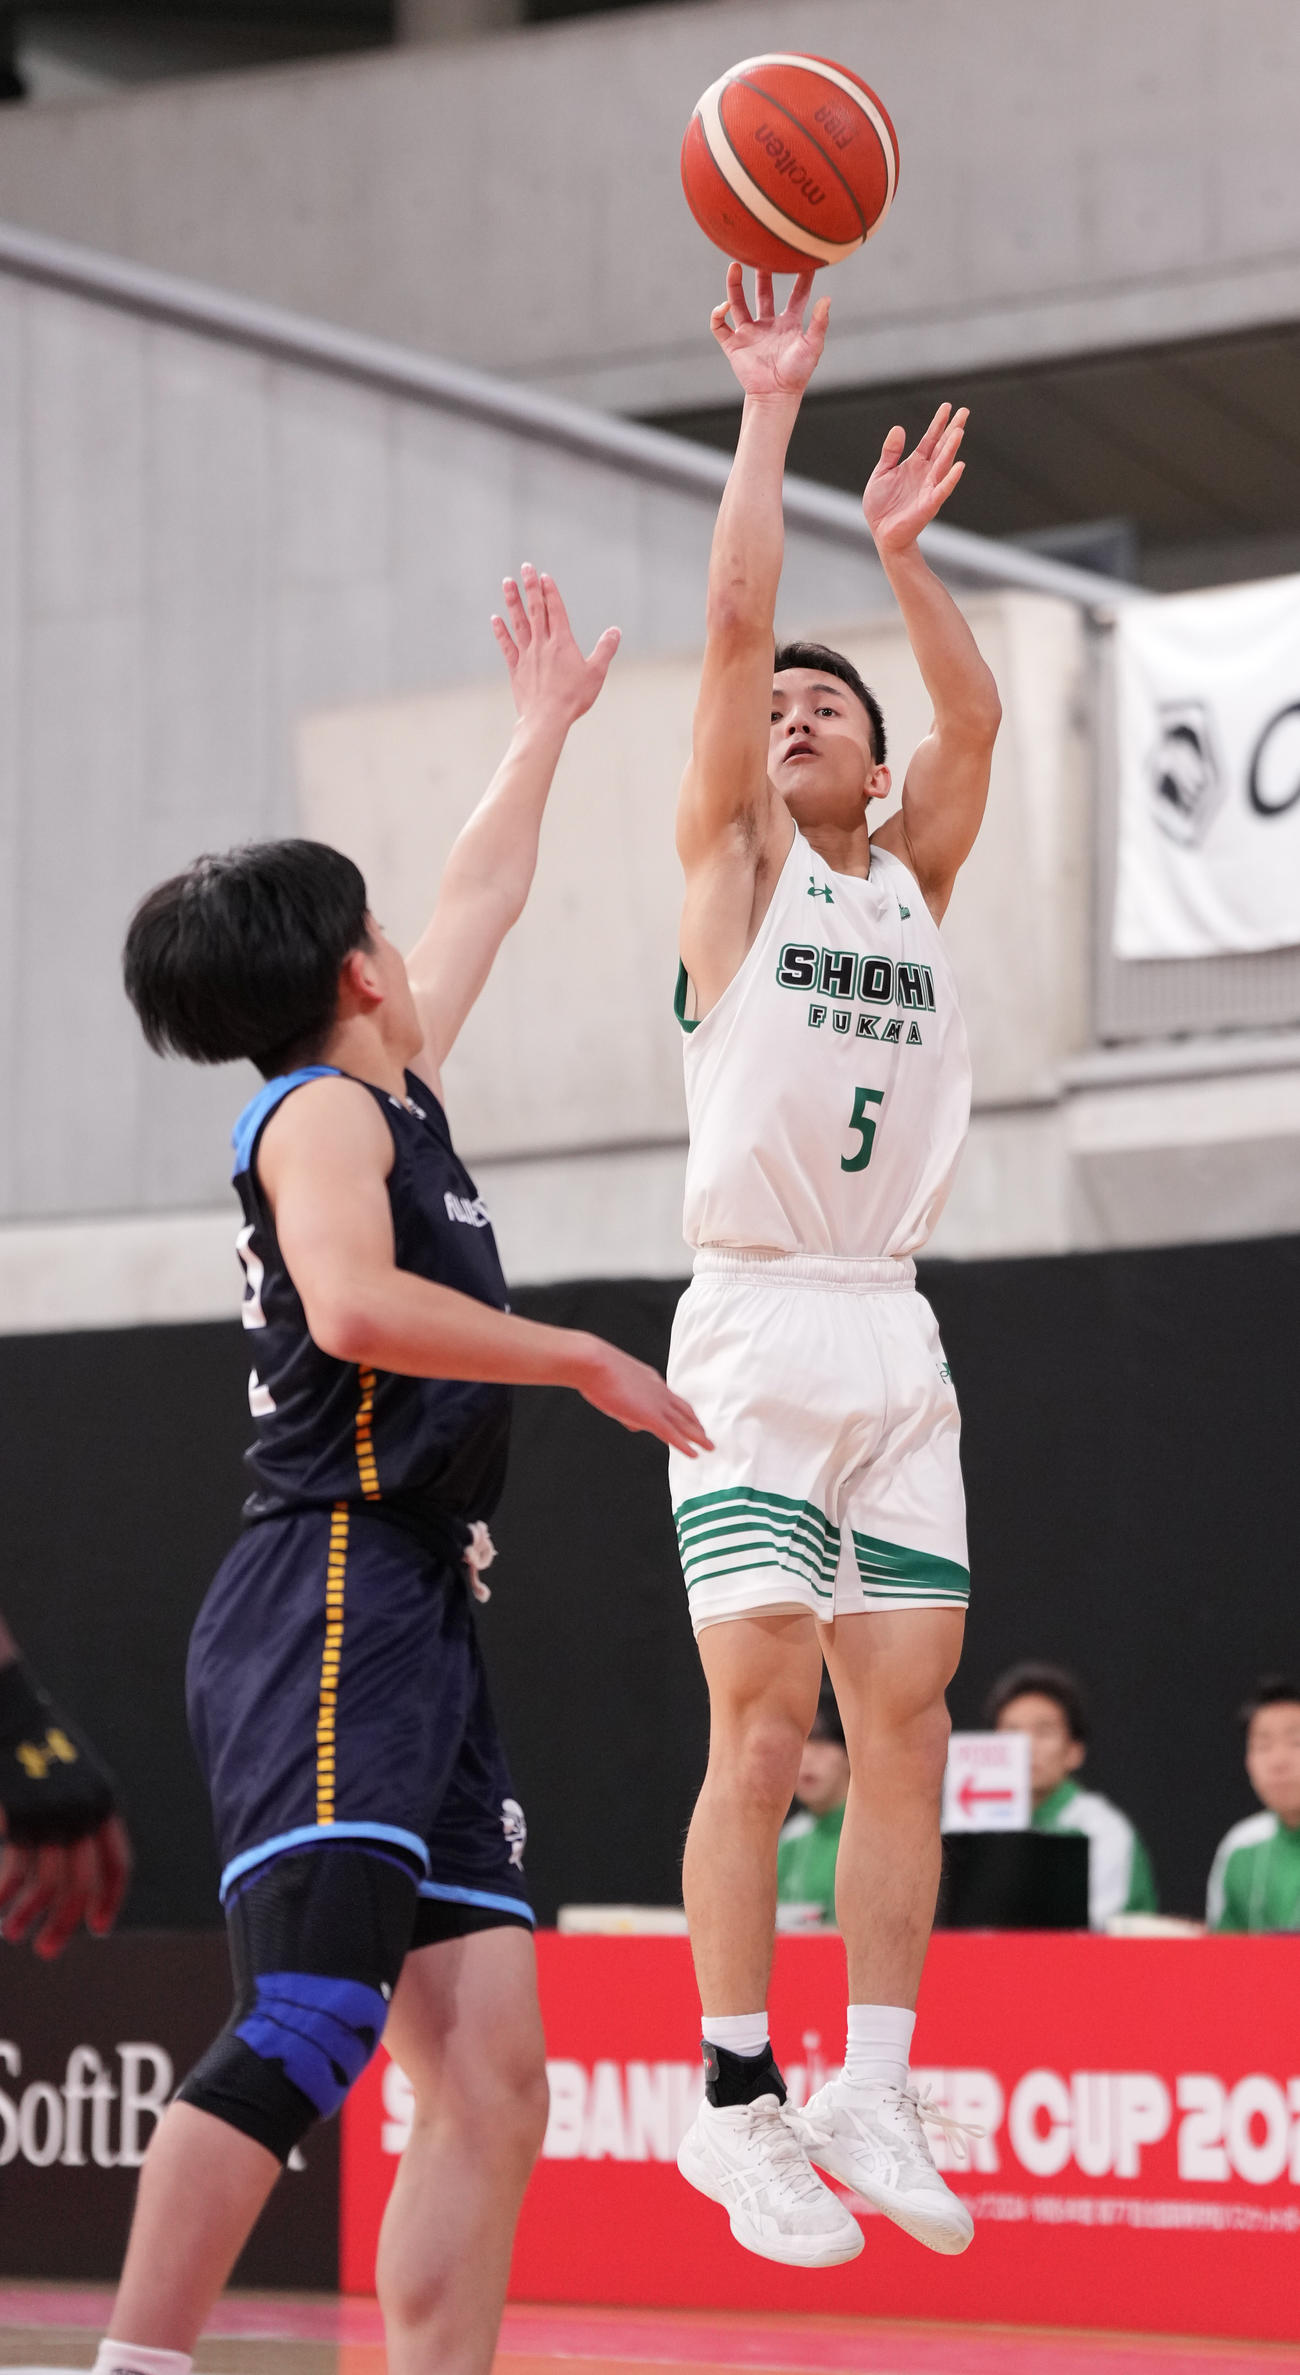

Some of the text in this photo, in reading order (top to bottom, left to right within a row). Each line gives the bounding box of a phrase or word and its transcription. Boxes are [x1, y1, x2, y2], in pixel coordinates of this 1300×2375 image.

[754, 123, 826, 206] molten
[813, 105, 856, 151] FIBA
[841, 1086, 885, 1173] 5
[1008, 2068, 1172, 2179] CUP
[1175, 2071, 1300, 2186] 20
